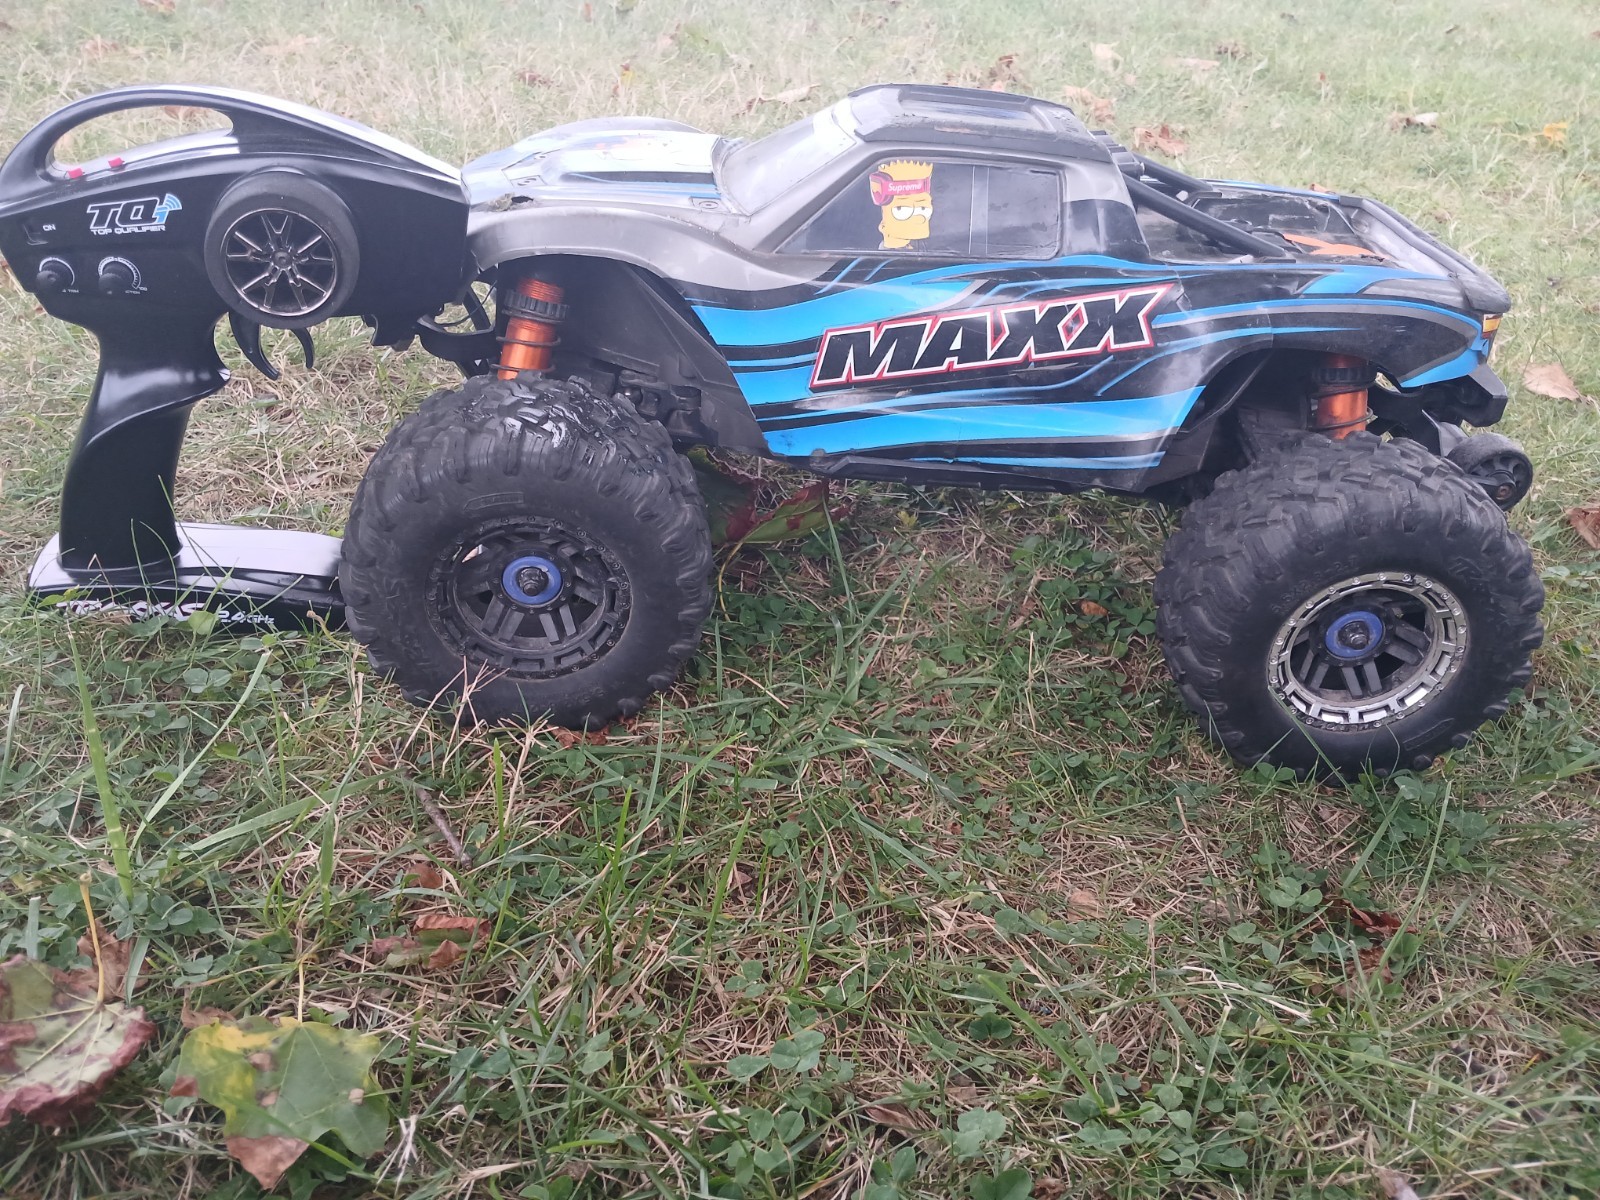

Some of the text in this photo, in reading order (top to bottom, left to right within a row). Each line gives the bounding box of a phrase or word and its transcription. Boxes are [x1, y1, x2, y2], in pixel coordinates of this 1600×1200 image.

[888, 183, 922, 194] Supreme
[42, 223, 56, 231] ON
[114, 225, 166, 235] QUALIFIER
[809, 283, 1175, 390] MAXX
